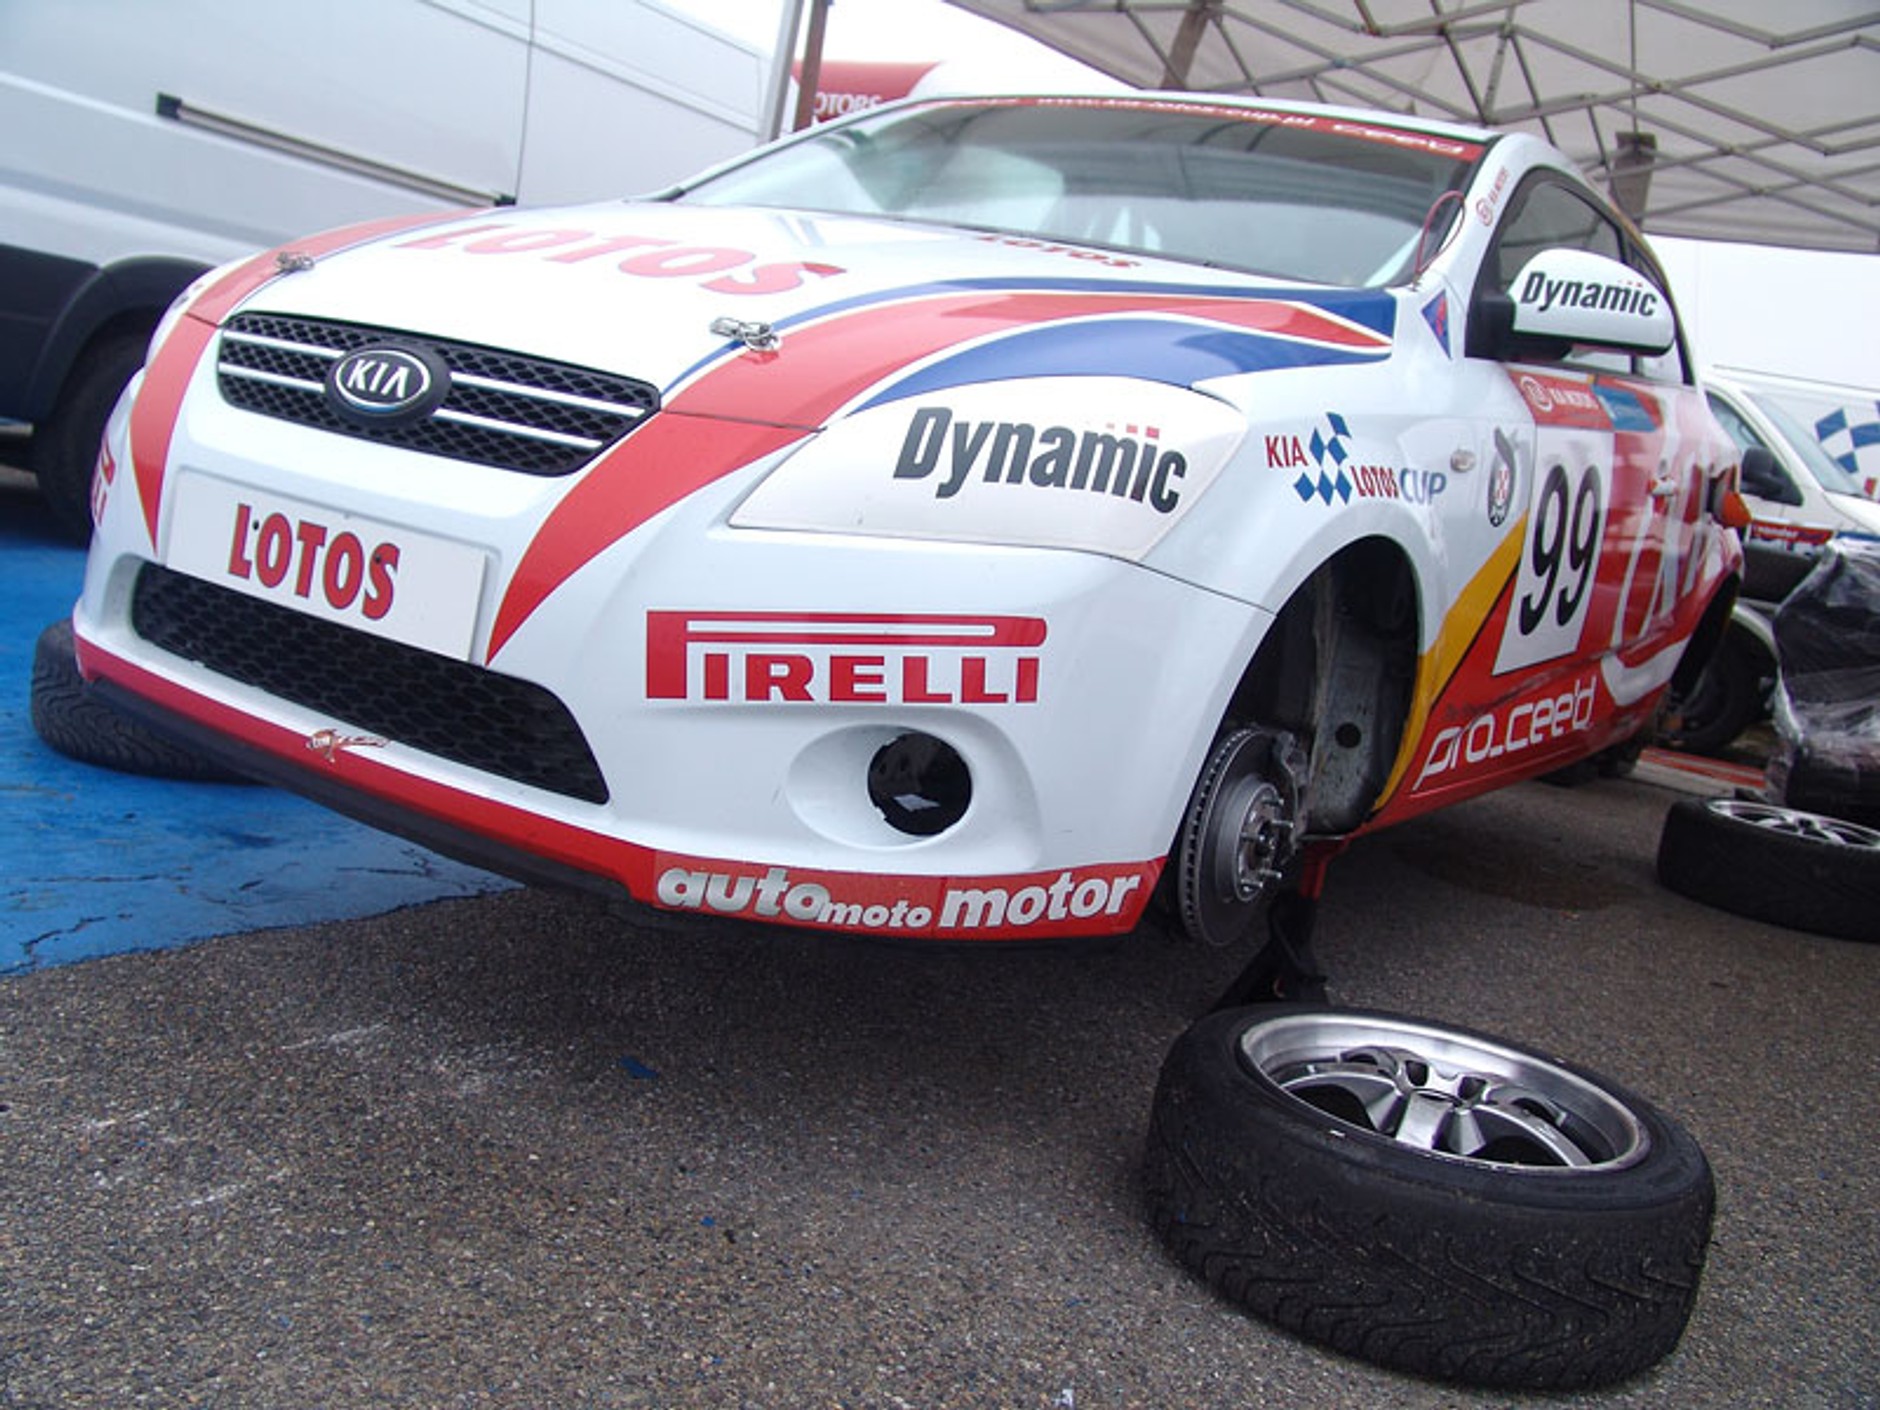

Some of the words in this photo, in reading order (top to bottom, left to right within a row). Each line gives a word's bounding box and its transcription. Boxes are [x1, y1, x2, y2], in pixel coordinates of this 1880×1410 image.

[394, 223, 847, 295] LOTOS
[974, 234, 1142, 268] LOTOS
[1520, 270, 1657, 317] Dynamic
[346, 359, 410, 399] KIA
[893, 406, 1187, 514] Dynamic
[1264, 435, 1309, 468] KIA
[1350, 465, 1400, 499] LOTOS
[1400, 468, 1447, 505] CUP
[228, 503, 401, 621] LOTOS
[1519, 465, 1602, 636] 99
[646, 610, 1047, 703] PIRELLI
[938, 871, 1142, 929] motor
